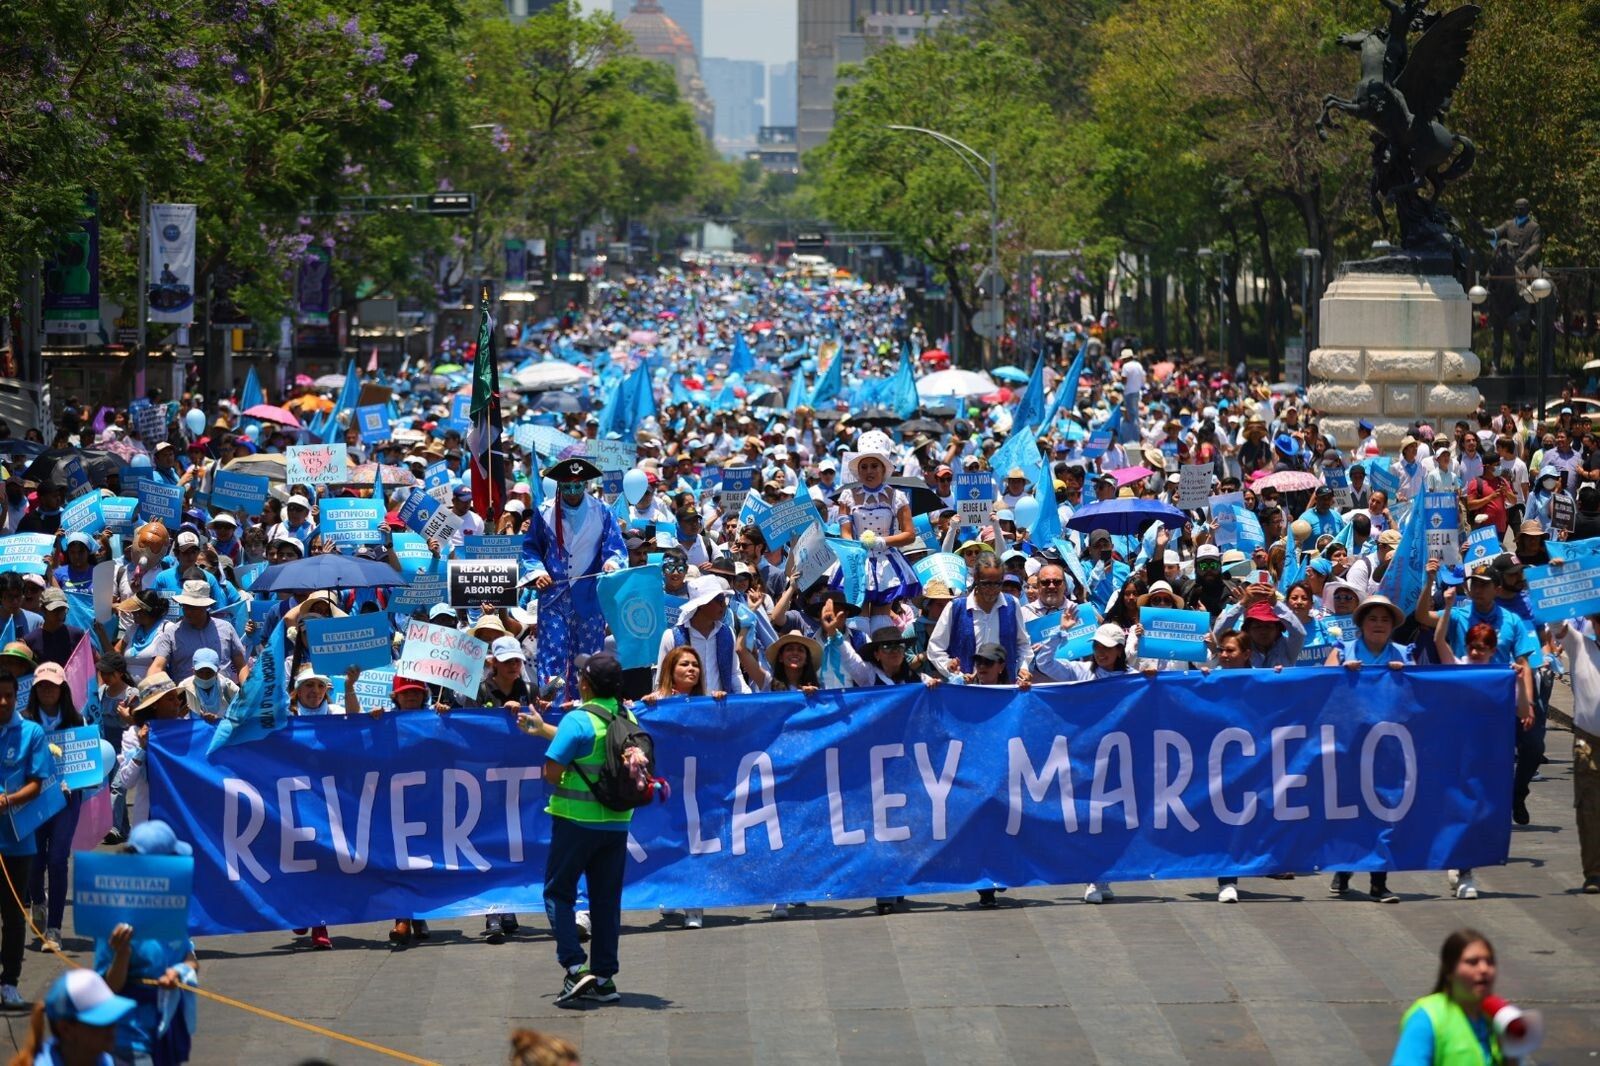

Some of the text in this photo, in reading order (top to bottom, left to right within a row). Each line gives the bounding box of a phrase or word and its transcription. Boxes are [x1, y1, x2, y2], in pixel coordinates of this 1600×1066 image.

[958, 475, 991, 484] AMA LA VIDA
[963, 503, 988, 512] ELIGE LA
[969, 515, 982, 523] VIDA
[426, 511, 448, 538] ELIGE LA
[438, 526, 454, 541] VIDA
[1442, 533, 1450, 545] LA
[460, 565, 508, 573] REZA POR
[458, 576, 510, 584] EL FIN DEL
[464, 586, 504, 594] ABORTO
[1154, 622, 1195, 630] REVIERTAN
[324, 629, 372, 640] REVIERTAN
[1067, 626, 1096, 639] ARCELO
[1170, 632, 1204, 641] MARCELO
[327, 644, 344, 652] LEY
[346, 640, 386, 652] MARCELO
[430, 649, 450, 660] es
[361, 672, 393, 682] PROVID
[365, 685, 384, 694] SER
[64, 741, 98, 750] MIENTAN
[223, 721, 1417, 883] REVERT LA LEY MARCELO
